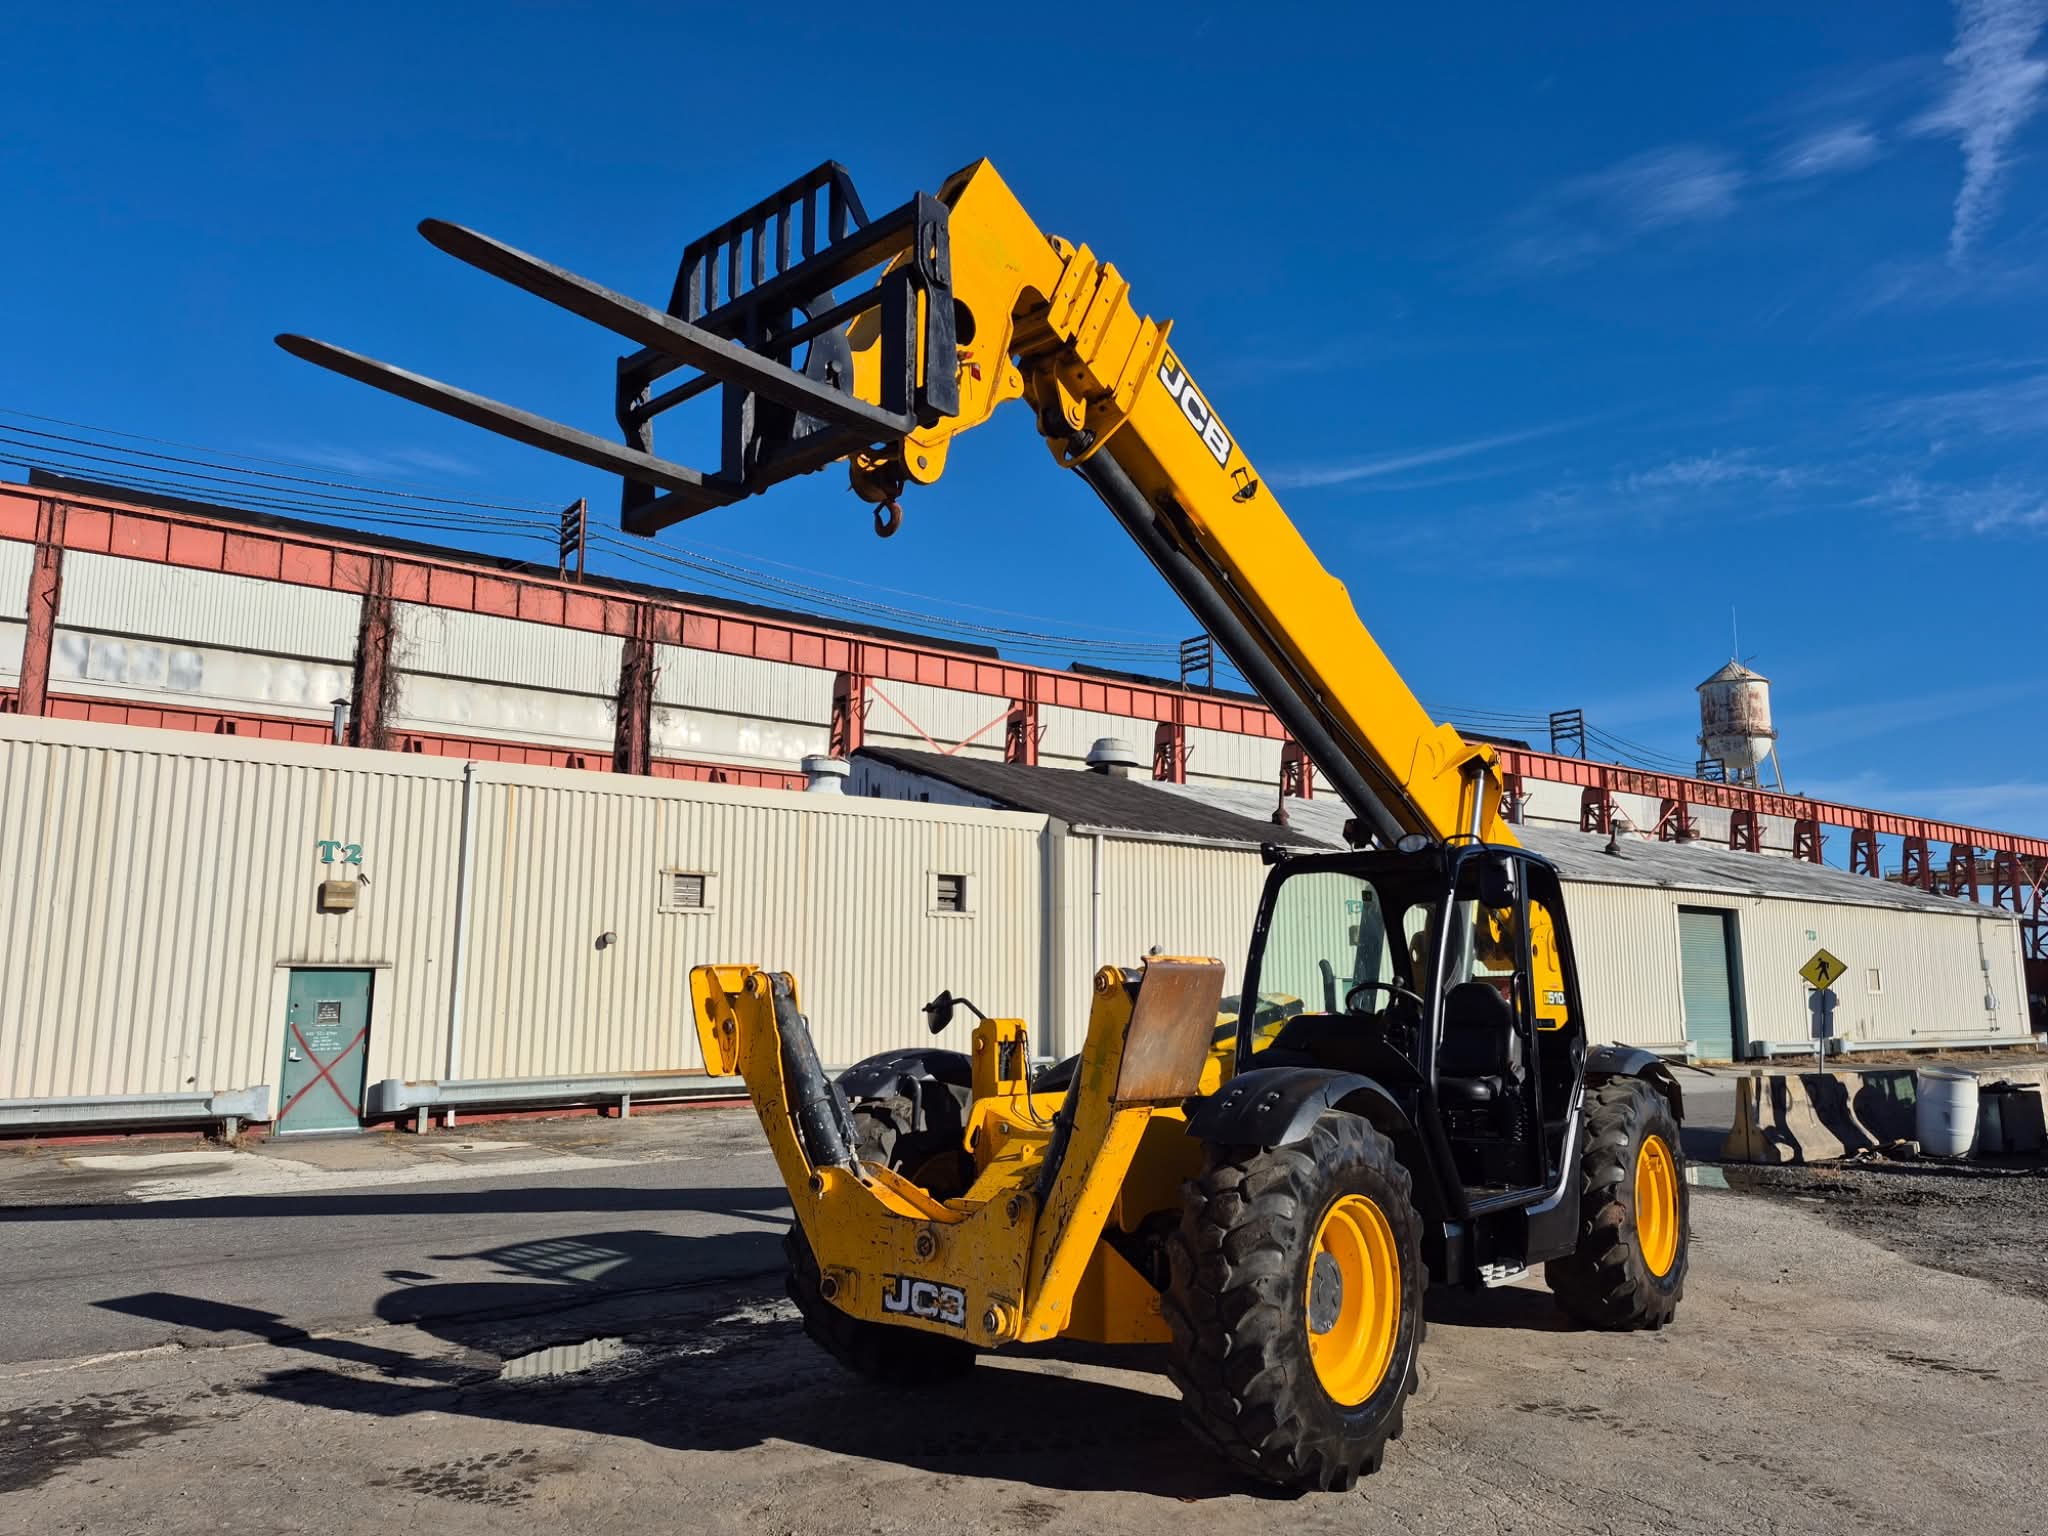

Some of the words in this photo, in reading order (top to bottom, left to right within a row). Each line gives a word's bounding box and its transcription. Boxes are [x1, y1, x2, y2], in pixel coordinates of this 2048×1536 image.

[1160, 366, 1231, 464] JCB
[318, 840, 363, 864] T2
[884, 1279, 965, 1324] JCB
